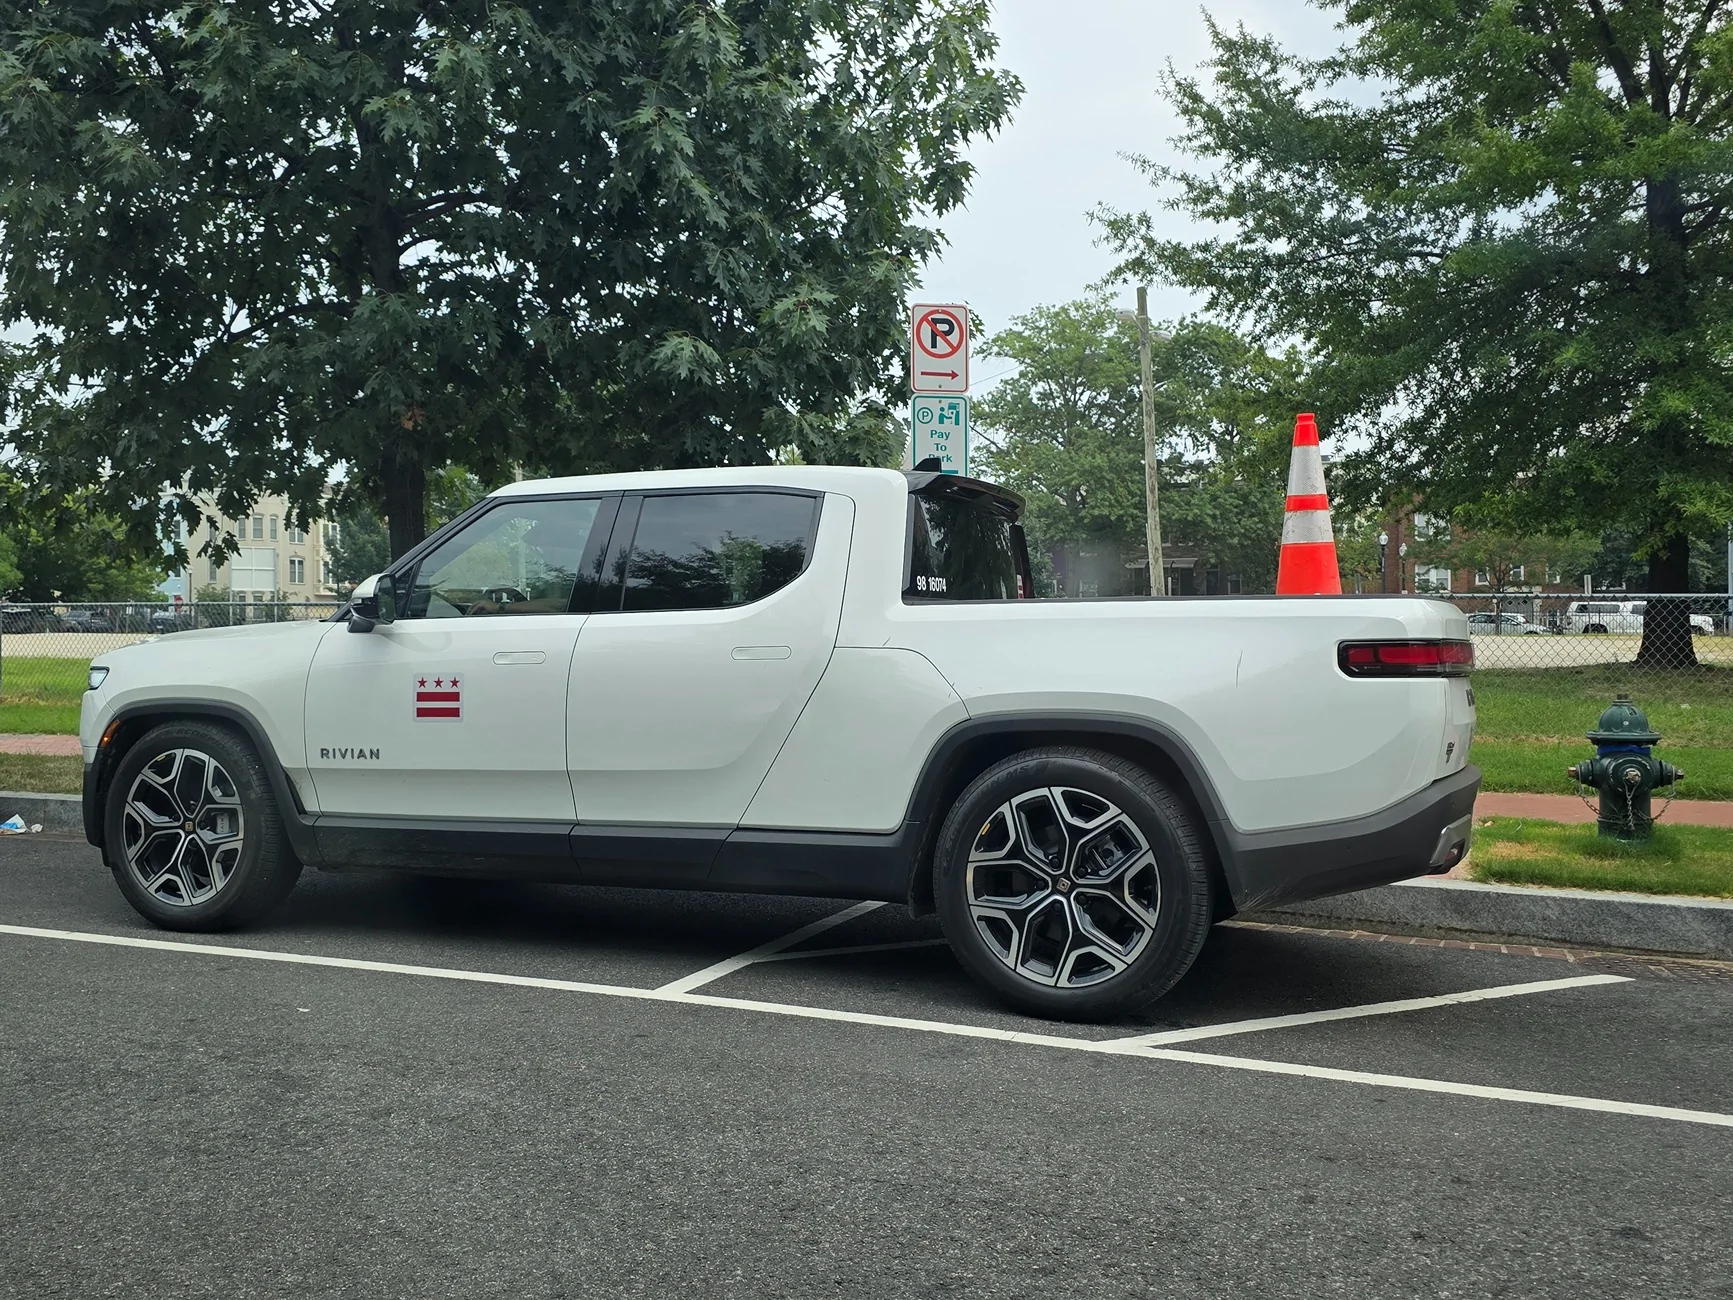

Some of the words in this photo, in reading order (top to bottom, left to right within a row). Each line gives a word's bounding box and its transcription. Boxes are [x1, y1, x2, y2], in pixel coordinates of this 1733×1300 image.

[930, 317, 955, 349] P
[921, 410, 930, 421] P
[930, 429, 951, 441] Pay
[934, 443, 947, 451] To
[928, 454, 953, 463] Prk
[916, 575, 927, 591] 98
[928, 577, 947, 592] 16074
[320, 747, 380, 760] RIVIAN
